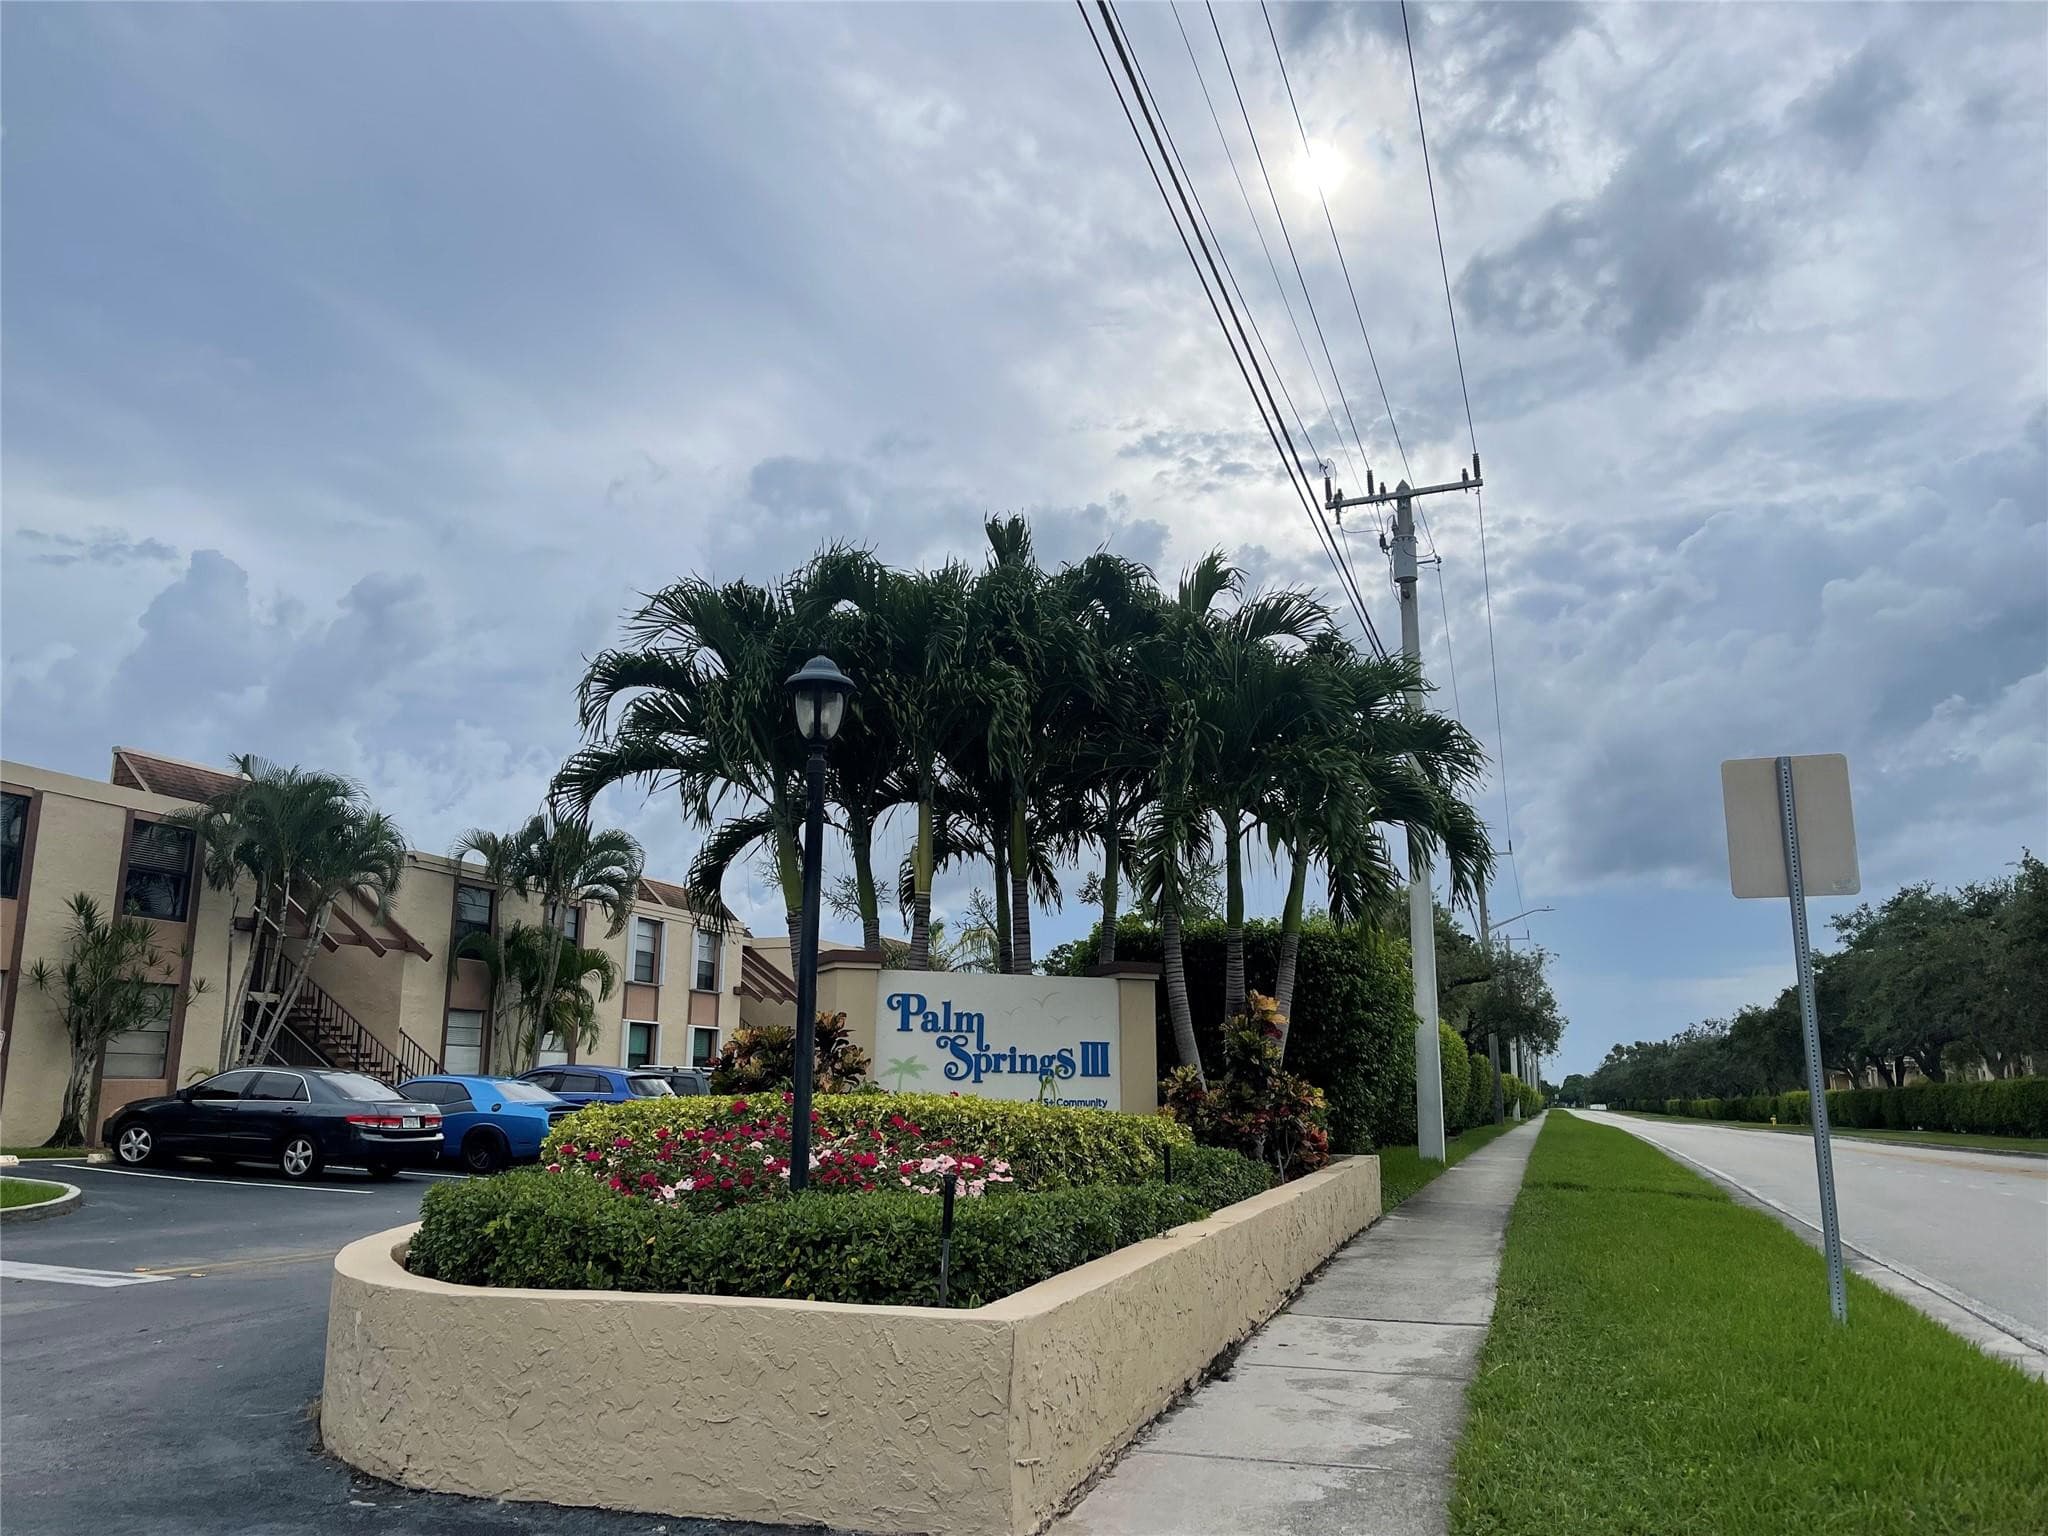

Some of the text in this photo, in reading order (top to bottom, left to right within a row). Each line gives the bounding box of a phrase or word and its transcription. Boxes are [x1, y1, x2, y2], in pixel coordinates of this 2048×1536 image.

[887, 993, 990, 1051] Palm
[1080, 1042, 1110, 1077] III
[1057, 1098, 1108, 1108] Community
